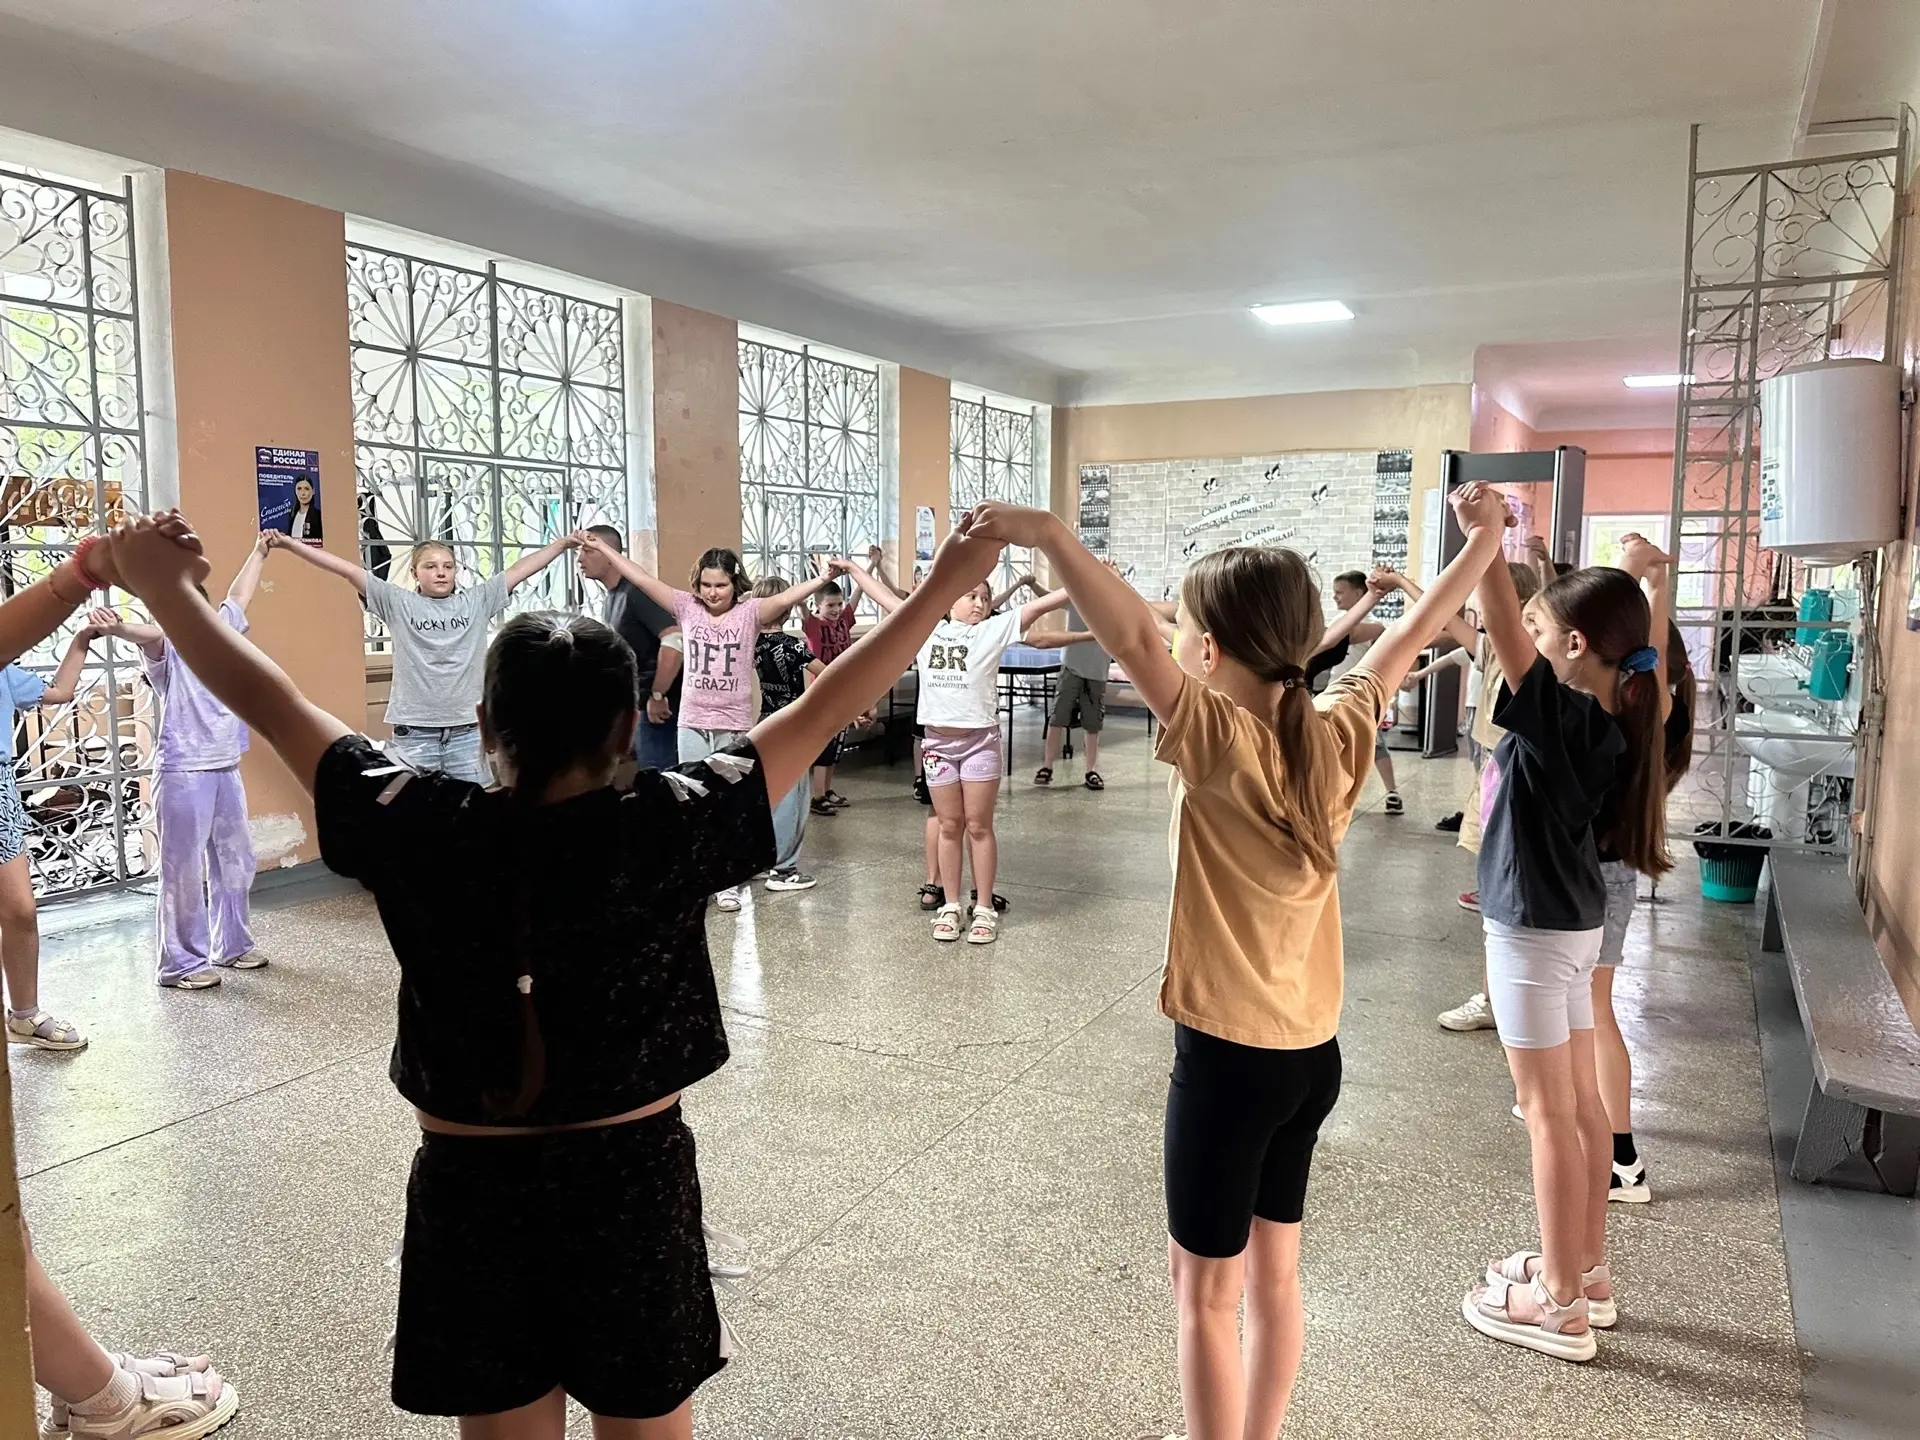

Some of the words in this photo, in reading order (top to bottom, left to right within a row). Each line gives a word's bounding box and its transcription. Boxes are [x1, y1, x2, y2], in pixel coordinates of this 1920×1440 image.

[272, 449, 306, 458] ЕДИНАЯ
[272, 456, 306, 465] РОССИЯ
[1202, 503, 1227, 518] Слава
[1230, 493, 1251, 506] тебе
[717, 628, 740, 642] MY
[688, 639, 740, 677] BFF
[928, 644, 969, 672] BR
[694, 677, 739, 692] CRAZY!
